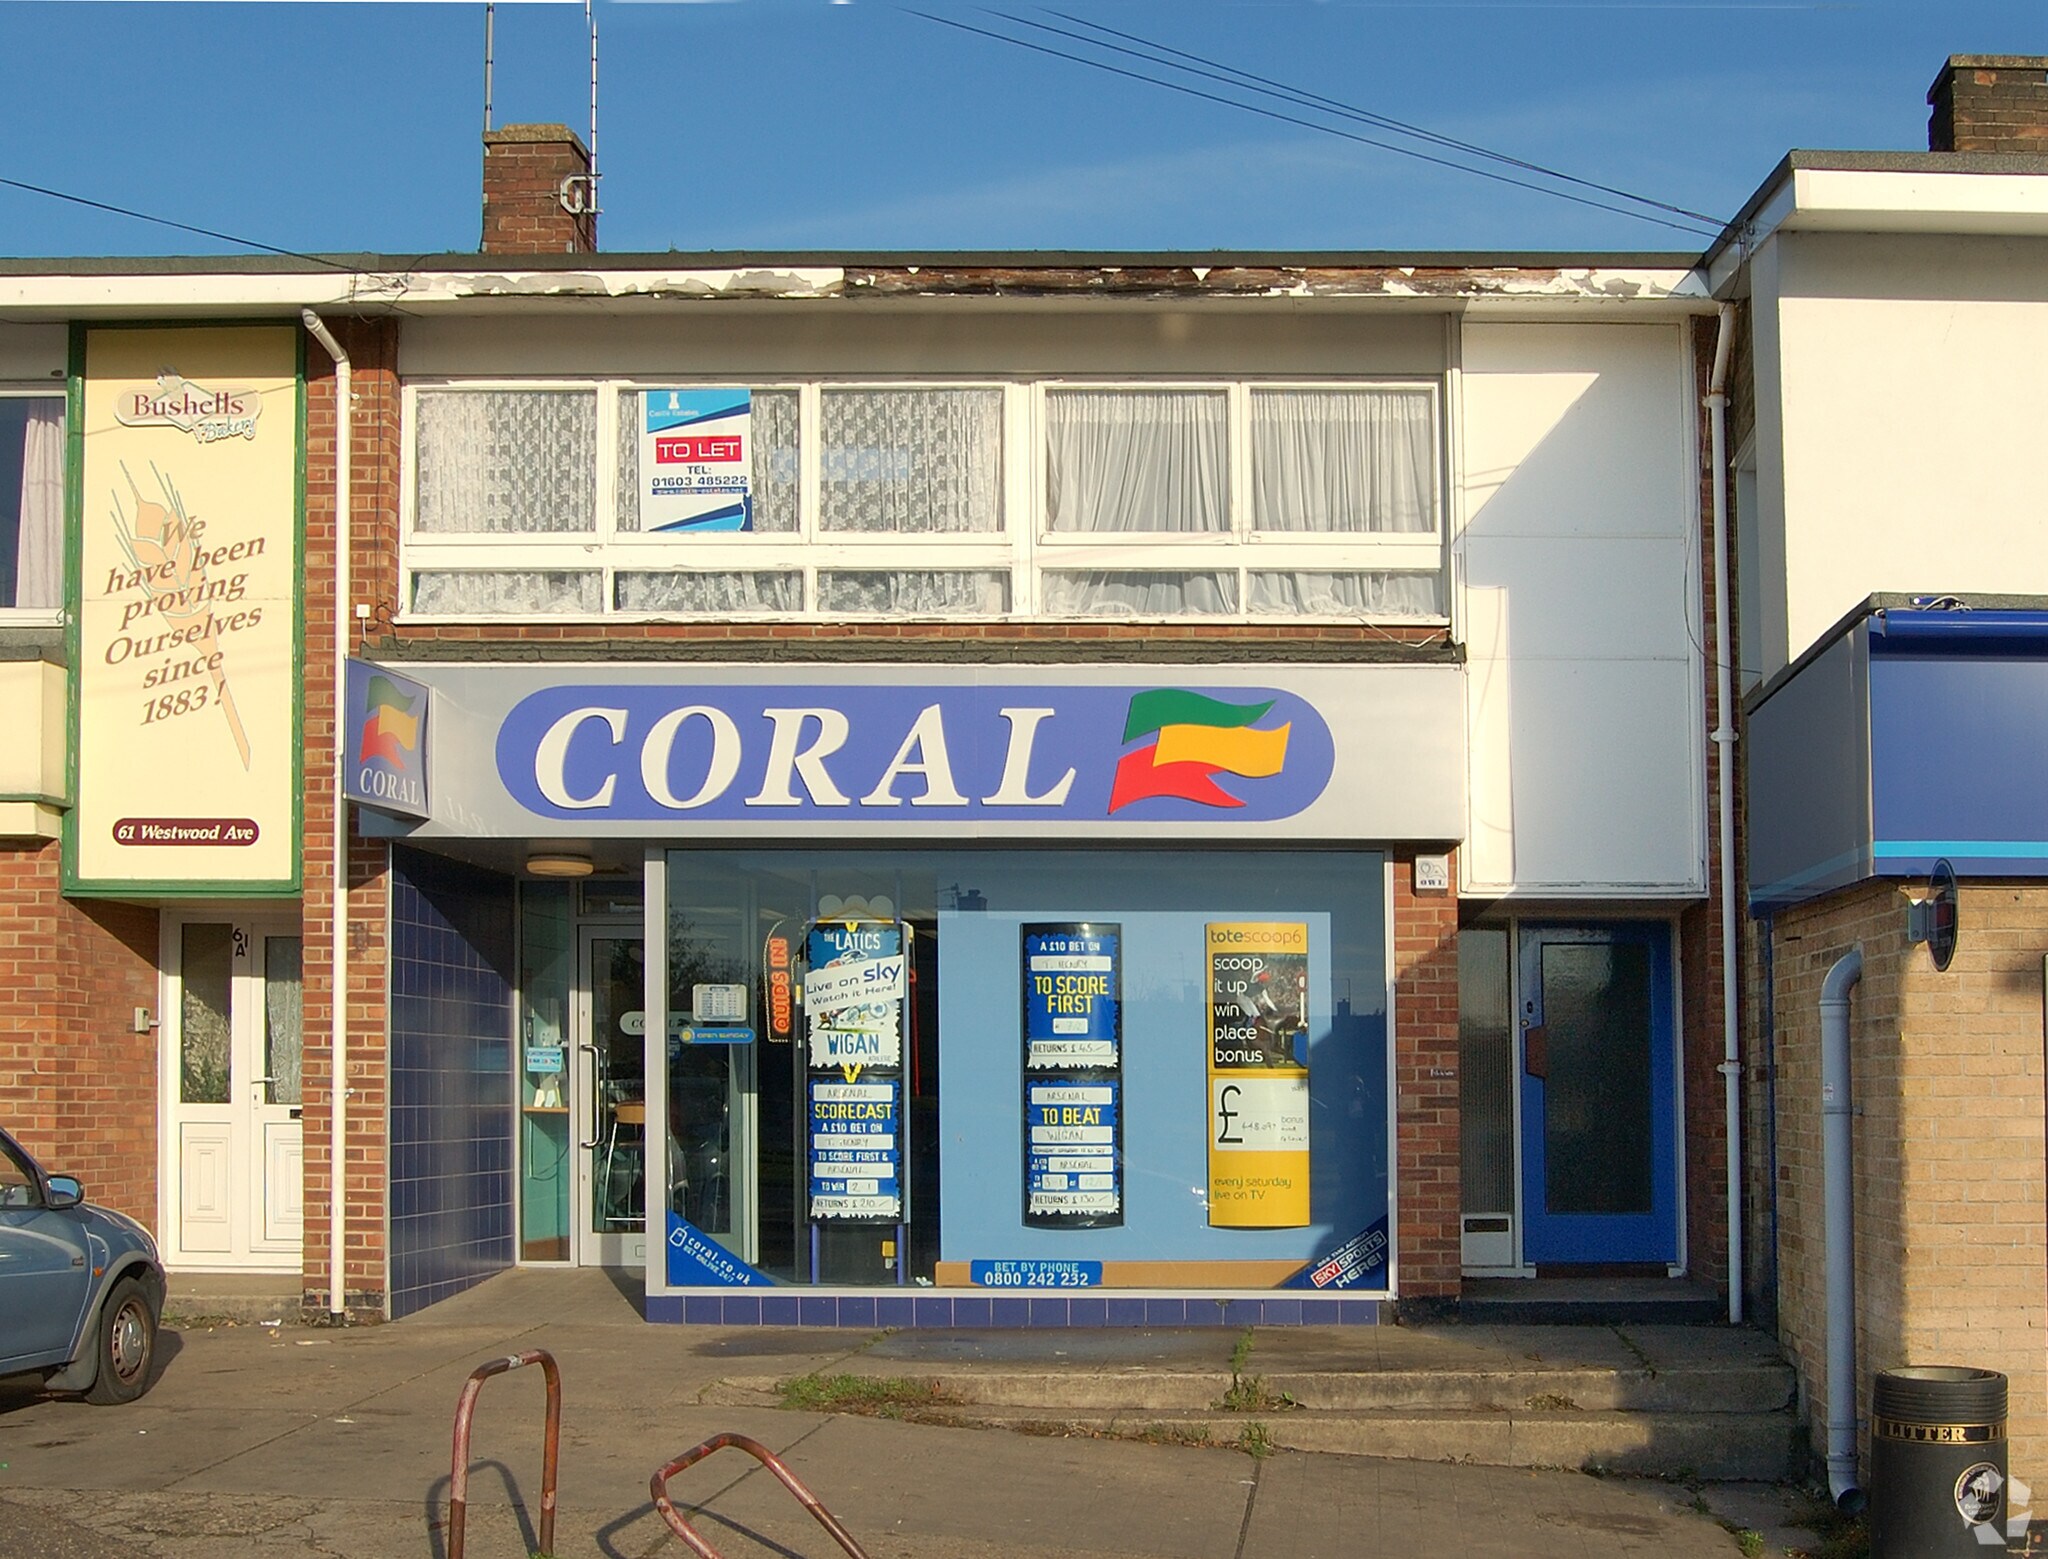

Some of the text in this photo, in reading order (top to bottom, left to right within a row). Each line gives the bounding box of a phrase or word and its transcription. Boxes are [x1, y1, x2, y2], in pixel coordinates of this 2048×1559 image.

[134, 392, 244, 416] Bushells
[658, 442, 739, 458] TO LET
[687, 466, 712, 475] TEL:
[652, 475, 748, 487] 01603 485222
[163, 515, 206, 547] We
[103, 537, 265, 595] have been
[118, 573, 249, 632] proving
[105, 607, 262, 665] Ourselves
[143, 651, 224, 689] since
[534, 703, 1076, 809] CORAL
[360, 767, 420, 806] CORAL
[118, 824, 254, 840] 61 Westwood Ave
[835, 933, 881, 950] LATICS
[1210, 928, 1302, 944] totescoop6
[1040, 941, 1047, 951] A
[1049, 941, 1066, 951] £10
[1068, 941, 1085, 951] BET
[1214, 957, 1264, 973] scoop
[806, 962, 901, 995] Live on sky
[1034, 976, 1109, 995] TO SCORE
[1214, 978, 1248, 997] it up
[772, 972, 790, 1031] QUIDS
[811, 983, 897, 1006] Watch it Here!
[1047, 994, 1093, 1014] FIRST
[1214, 1001, 1240, 1017] win
[1214, 1024, 1258, 1043] place
[827, 1034, 879, 1055] WIGAN
[1034, 1044, 1067, 1053] RETURNS
[1215, 1046, 1264, 1063] bonus
[815, 1103, 892, 1119] SCORECAST
[1041, 1107, 1101, 1125] TO BEAT
[1217, 1085, 1243, 1144] £
[821, 1122, 829, 1133] A
[850, 1122, 866, 1133] BET
[818, 1151, 827, 1161] TO
[829, 1151, 854, 1161] SCORE
[856, 1151, 880, 1161] FIRST
[1214, 1176, 1292, 1189] every saturday
[816, 1199, 849, 1208] RETURNS
[1035, 1195, 1069, 1204] RETURNS
[1214, 1189, 1266, 1200] live on TV
[687, 1237, 751, 1286] coral.co.uk
[994, 1262, 1079, 1273] BET BY PHONE
[1314, 1233, 1383, 1284] SKY SPORTS
[984, 1271, 1089, 1286] 0800 242 232
[1335, 1252, 1384, 1289] HERE!
[1887, 1422, 1967, 1442] LITTER
